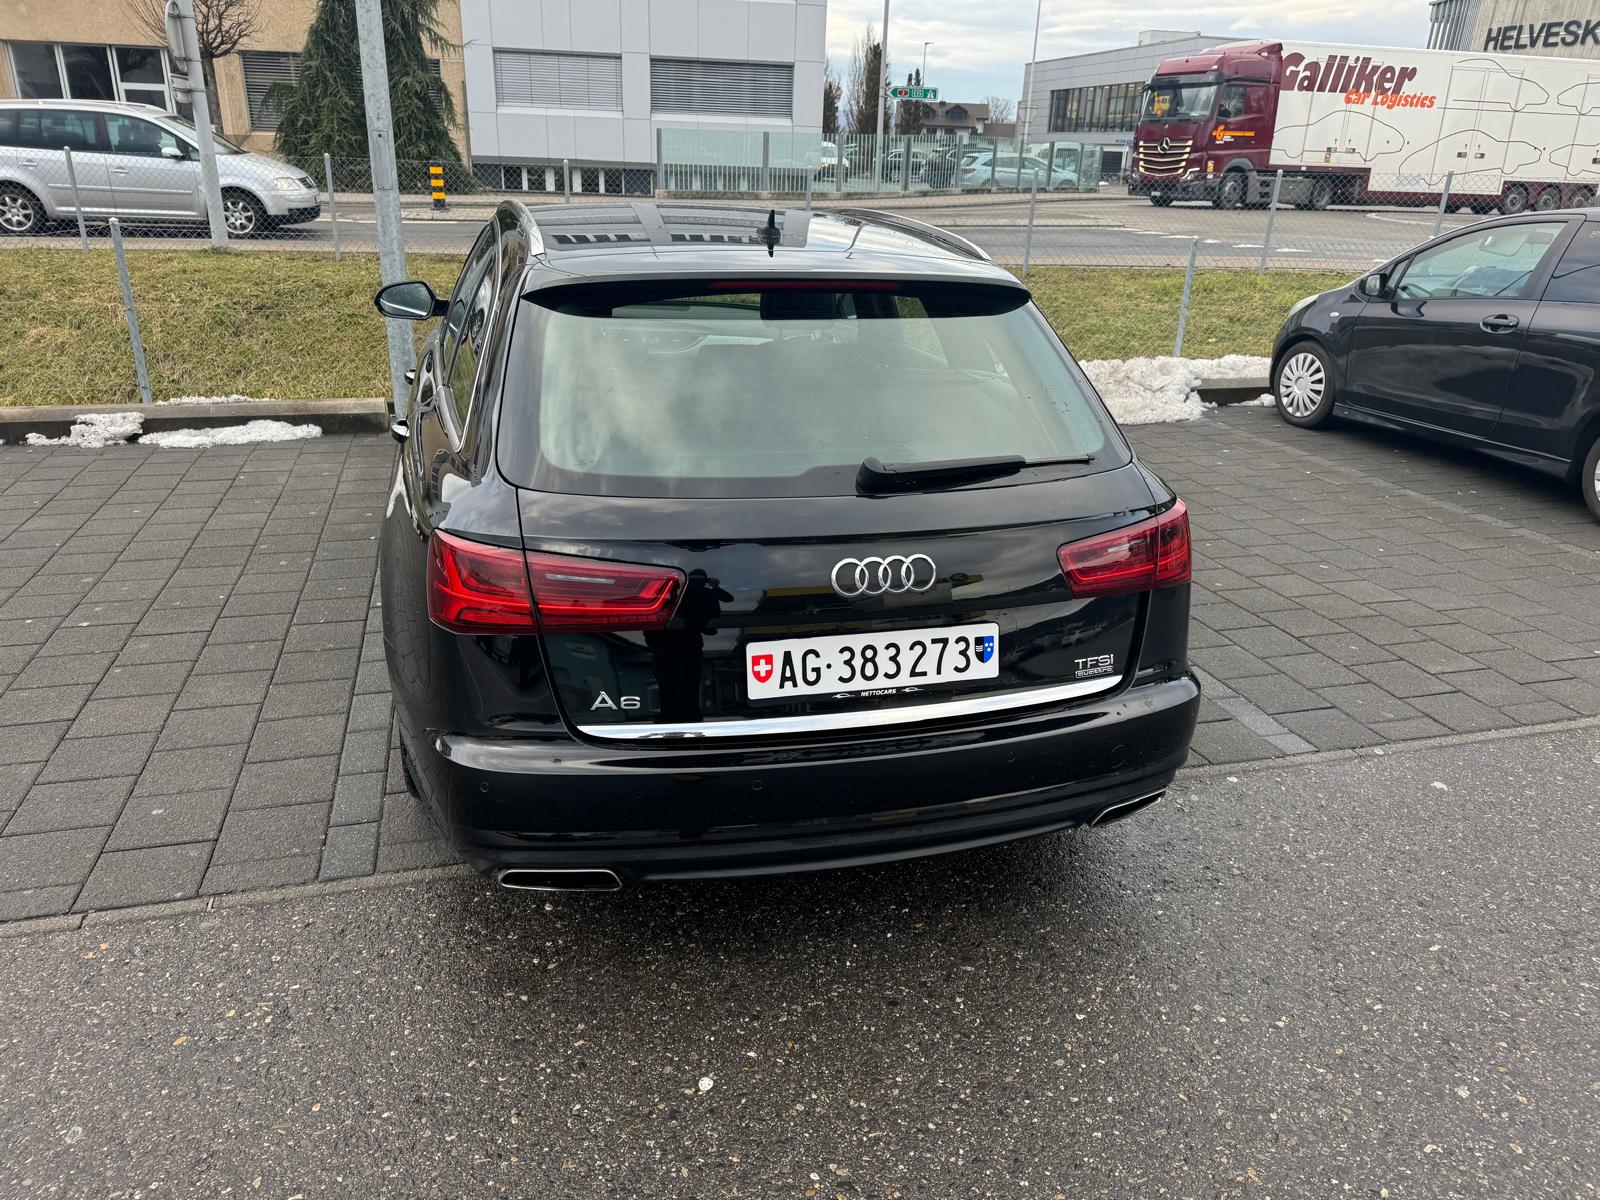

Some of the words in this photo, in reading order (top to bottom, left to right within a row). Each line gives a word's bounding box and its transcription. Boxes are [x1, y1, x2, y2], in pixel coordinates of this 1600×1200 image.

[1483, 19, 1600, 51] HELVESK
[1281, 52, 1418, 95] Galliker
[1344, 88, 1371, 105] Car
[1371, 90, 1437, 110] Logistics
[1076, 666, 1113, 678] quattro
[590, 691, 641, 710] A6
[860, 688, 897, 697] NETTOCARS
